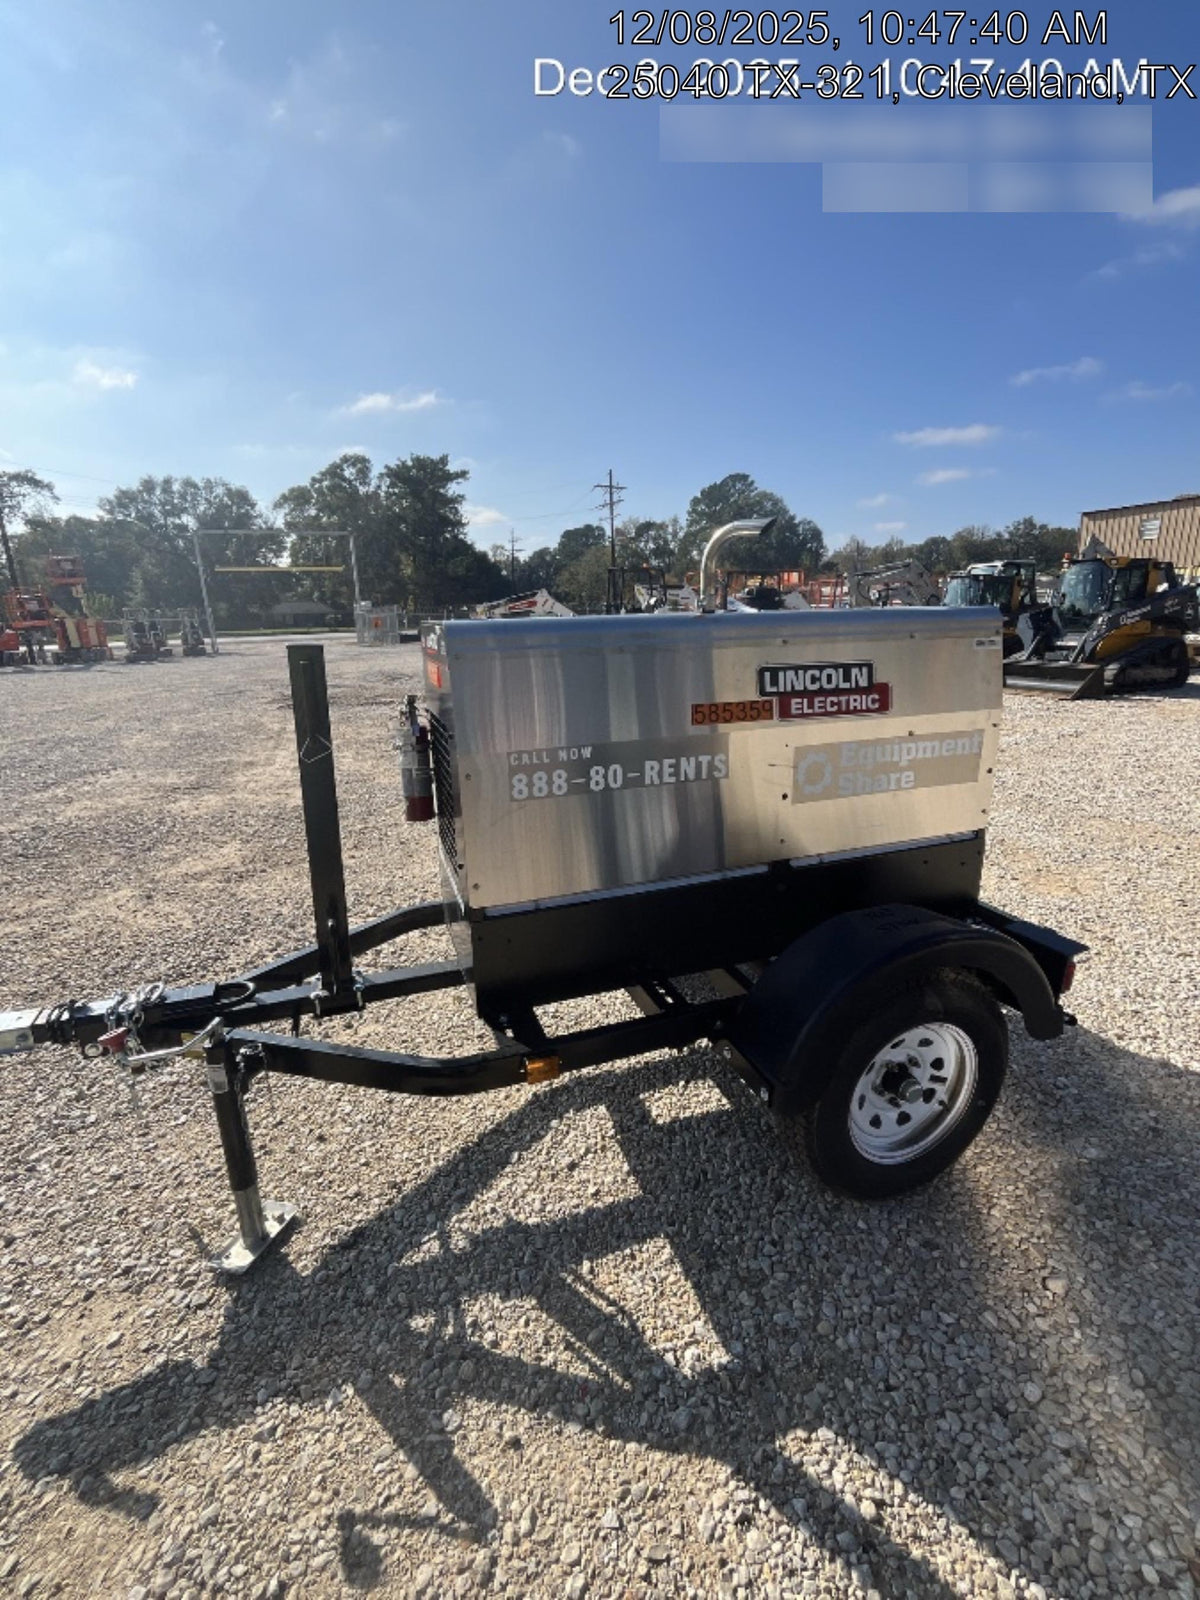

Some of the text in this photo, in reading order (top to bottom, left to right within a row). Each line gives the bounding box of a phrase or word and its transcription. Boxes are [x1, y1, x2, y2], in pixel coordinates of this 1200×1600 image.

[764, 666, 869, 693] LINCOLN
[694, 700, 774, 725] 585359
[790, 693, 880, 715] ELECTRIC
[509, 746, 593, 766] CALL NOW
[839, 733, 983, 767] Equipment
[511, 753, 728, 800] 888-80-RENTS
[837, 770, 915, 795] Share
